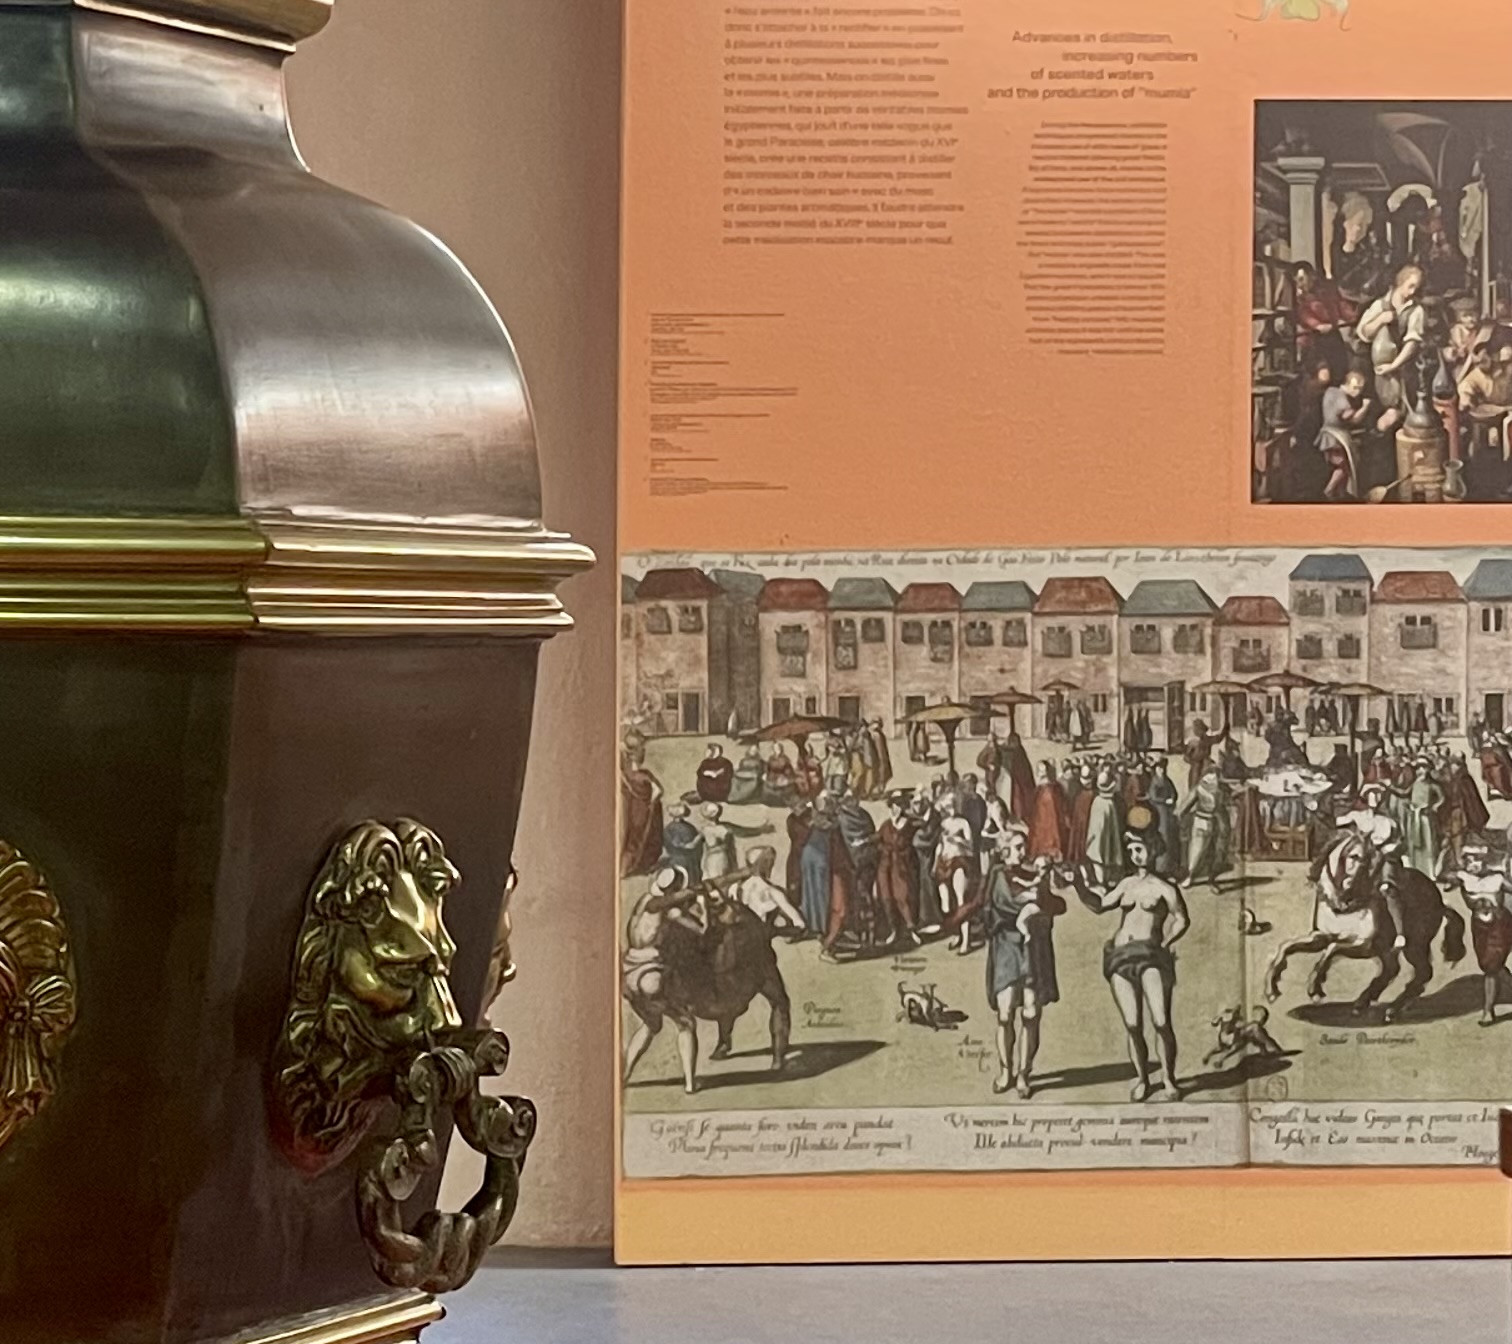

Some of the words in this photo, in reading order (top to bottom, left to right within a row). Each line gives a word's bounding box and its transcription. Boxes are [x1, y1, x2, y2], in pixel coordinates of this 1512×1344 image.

[1012, 31, 1080, 42] Advances
[1084, 32, 1096, 42] in
[1031, 68, 1044, 79] of
[1108, 70, 1154, 80] waters
[987, 87, 1013, 98] and
[1016, 87, 1039, 97] the
[1042, 87, 1118, 100] production
[1122, 87, 1135, 98] of
